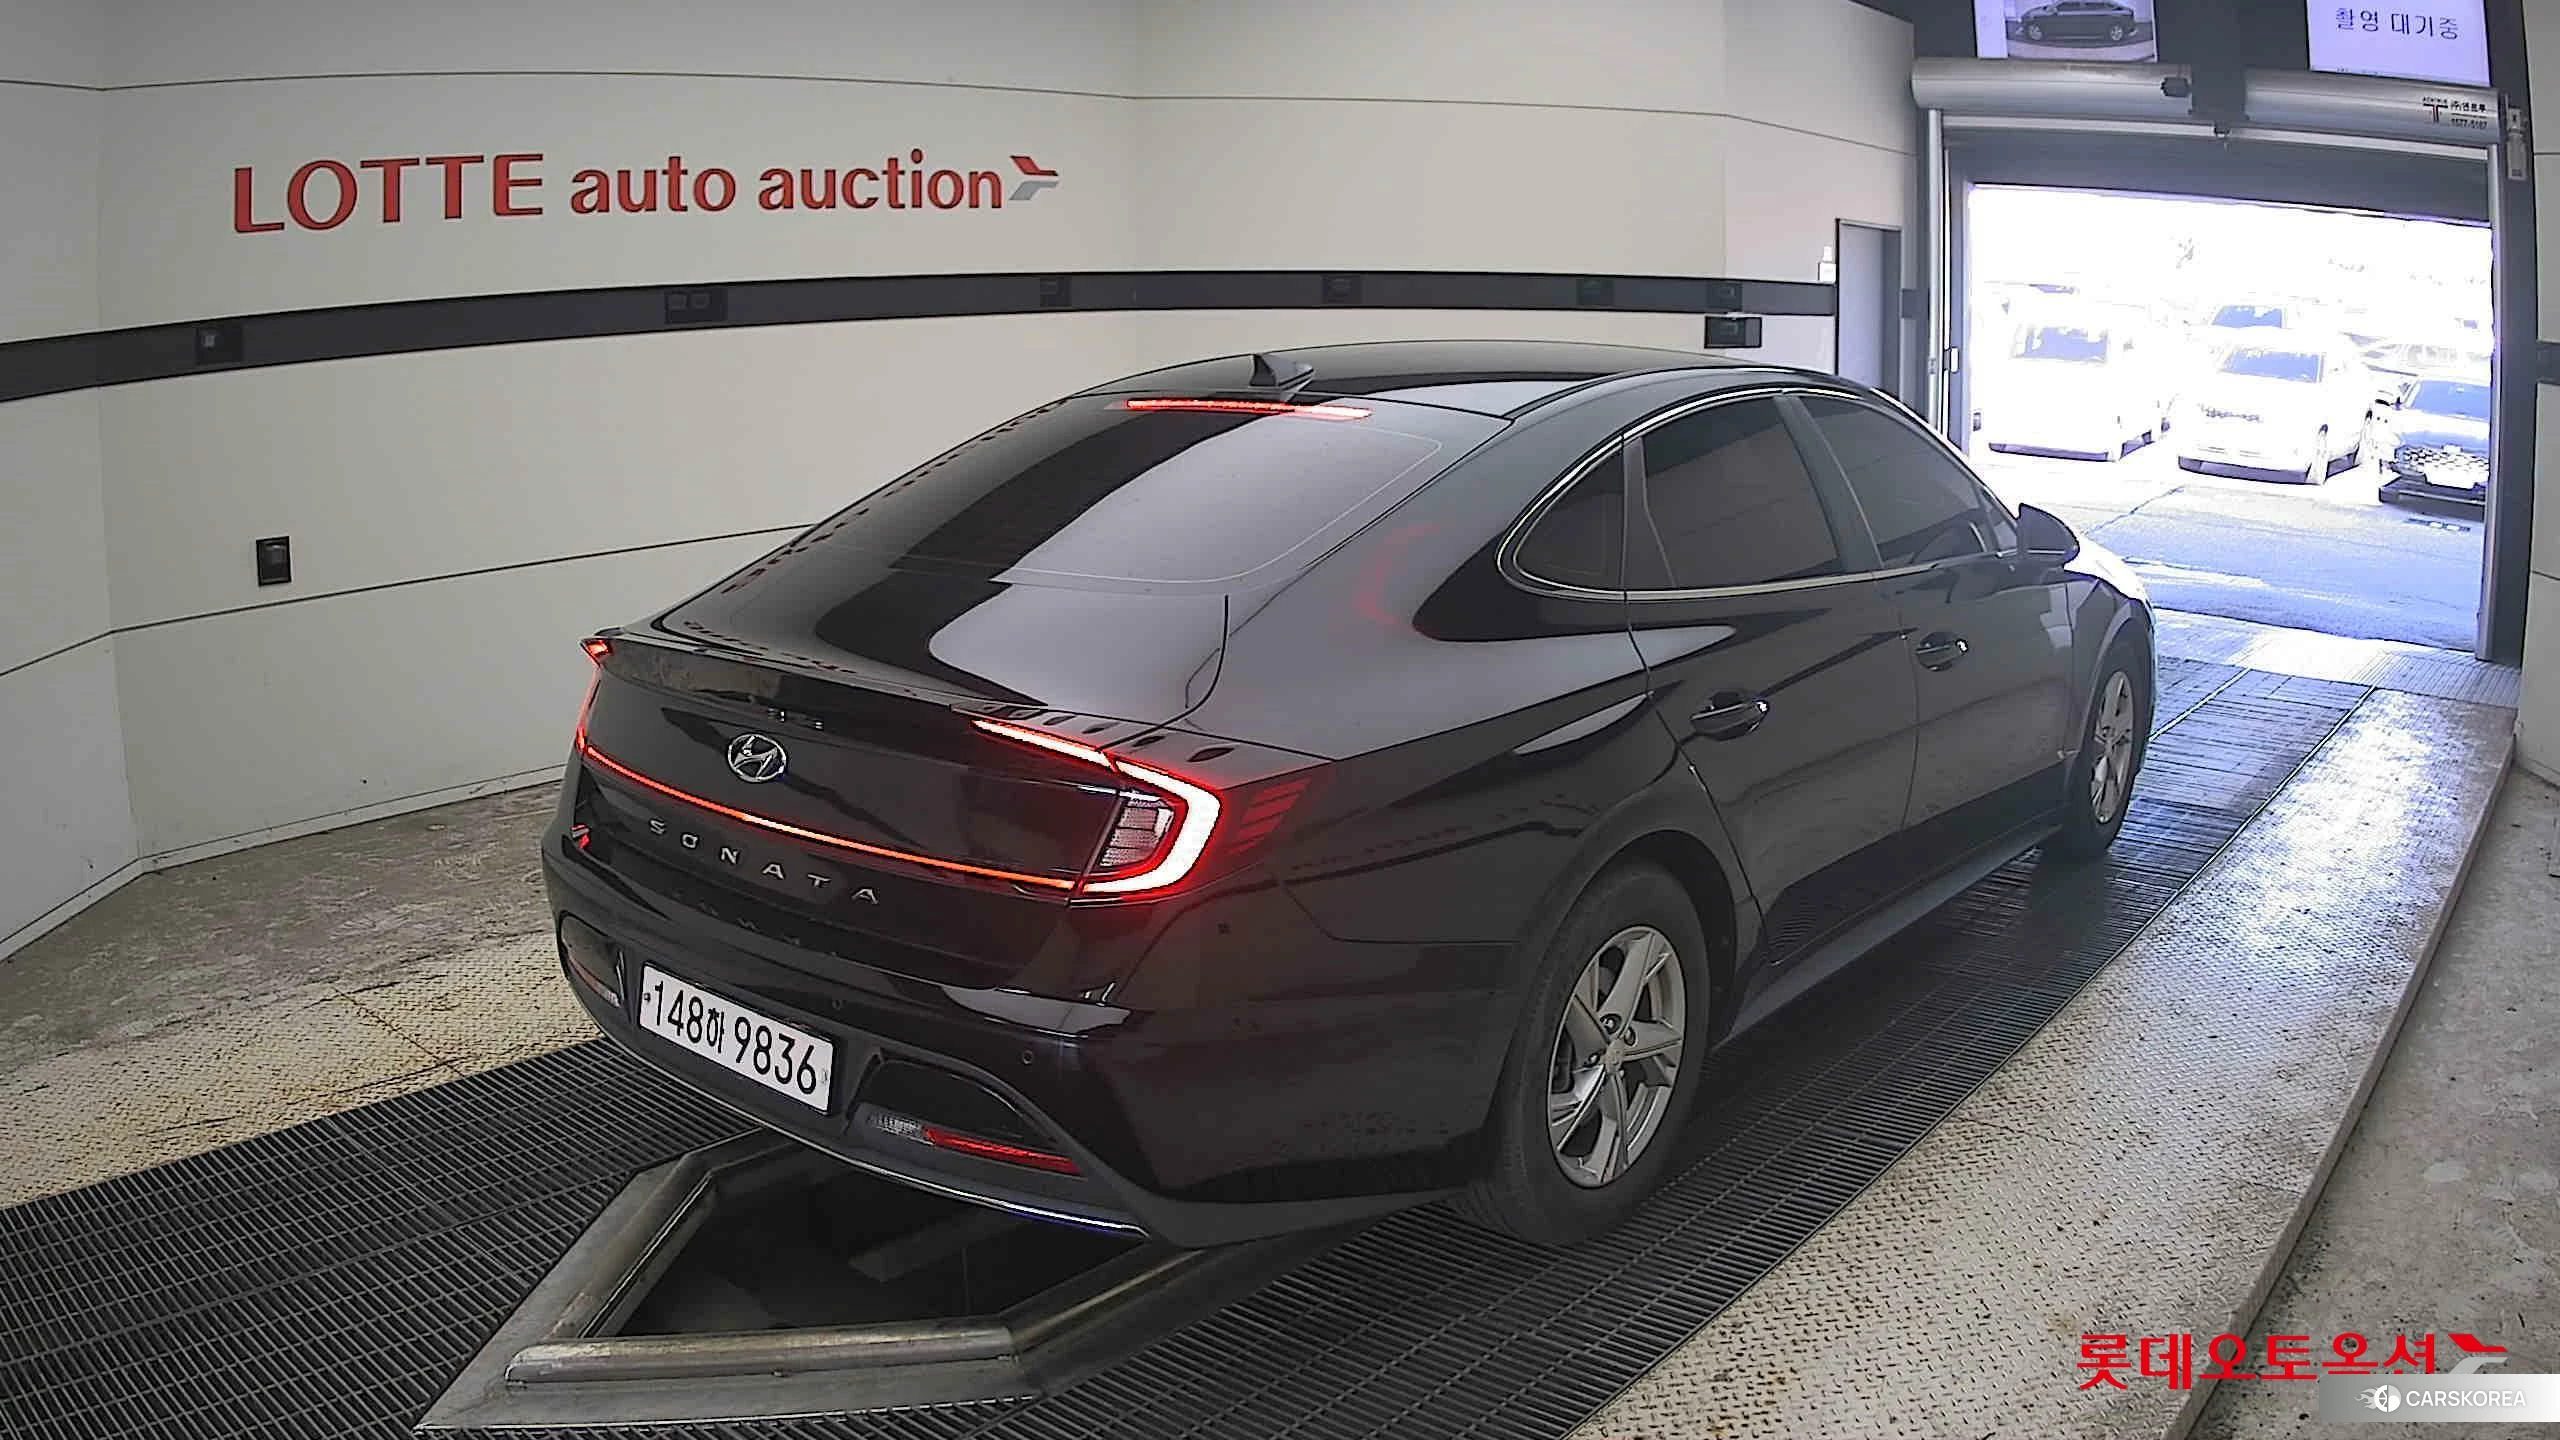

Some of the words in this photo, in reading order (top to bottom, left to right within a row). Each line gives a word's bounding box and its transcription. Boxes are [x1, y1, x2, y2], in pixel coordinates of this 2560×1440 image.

[2335, 7, 2379, 32] 촬영
[233, 152, 544, 233] LOTTE
[570, 155, 736, 214] auto
[758, 148, 1003, 210] auction
[648, 817, 880, 905] SONATA
[653, 979, 726, 1055] 148하
[734, 1016, 818, 1095] 9836
